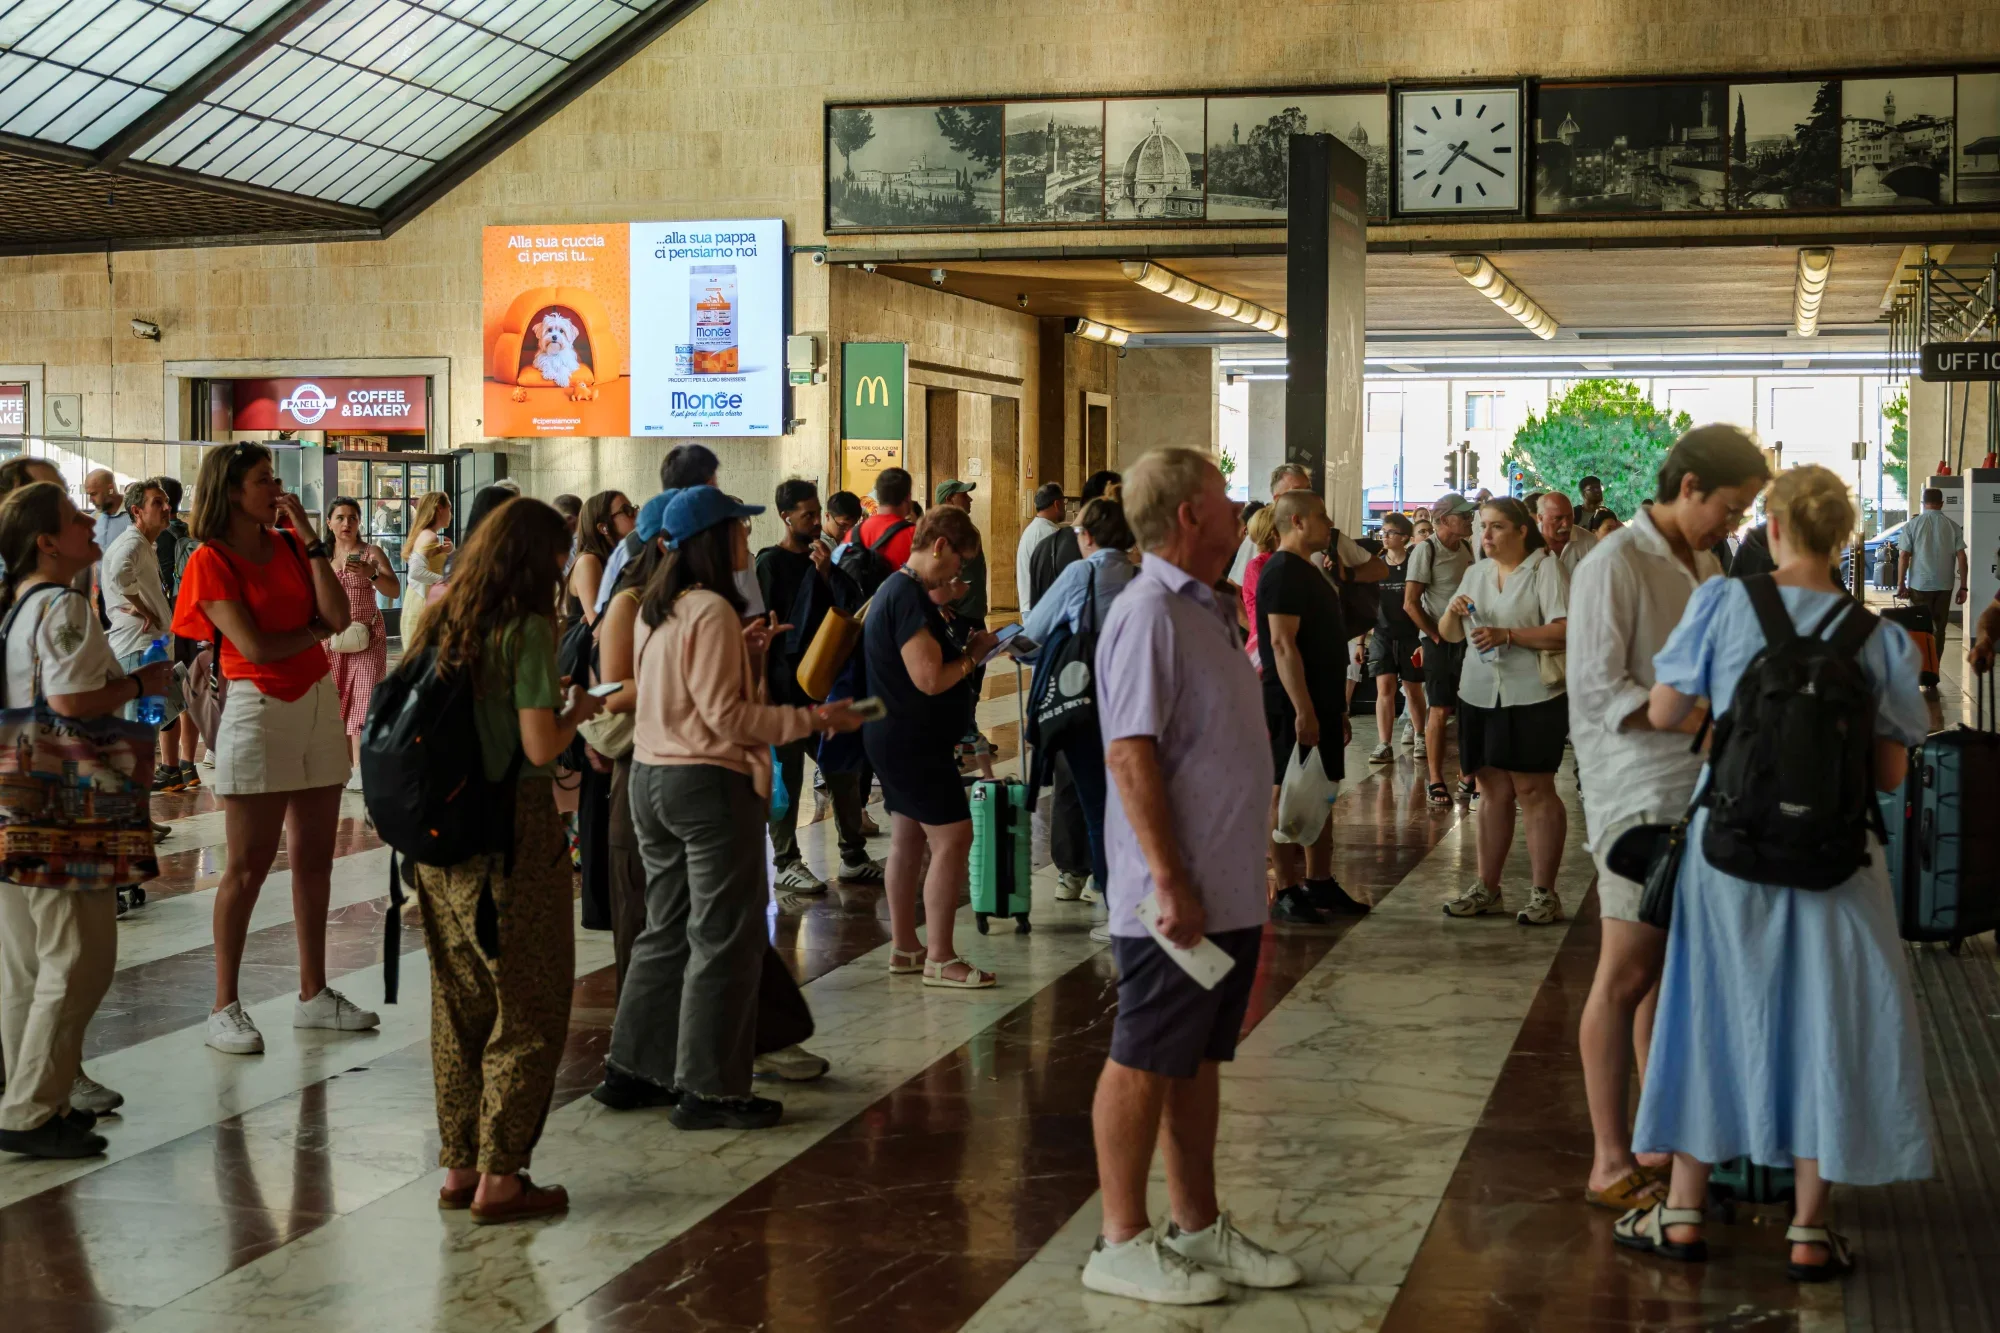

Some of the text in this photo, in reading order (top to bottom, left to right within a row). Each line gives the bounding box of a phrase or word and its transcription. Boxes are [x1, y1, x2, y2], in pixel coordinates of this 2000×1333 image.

[508, 234, 605, 248] Alla sua cuccia
[656, 231, 756, 246] ...alla sua pappa
[518, 250, 530, 262] ci
[533, 249, 568, 264] pensi
[654, 244, 758, 261] ci pensiamo noi
[348, 390, 405, 403] COFFEE
[287, 400, 328, 408] PANELLA
